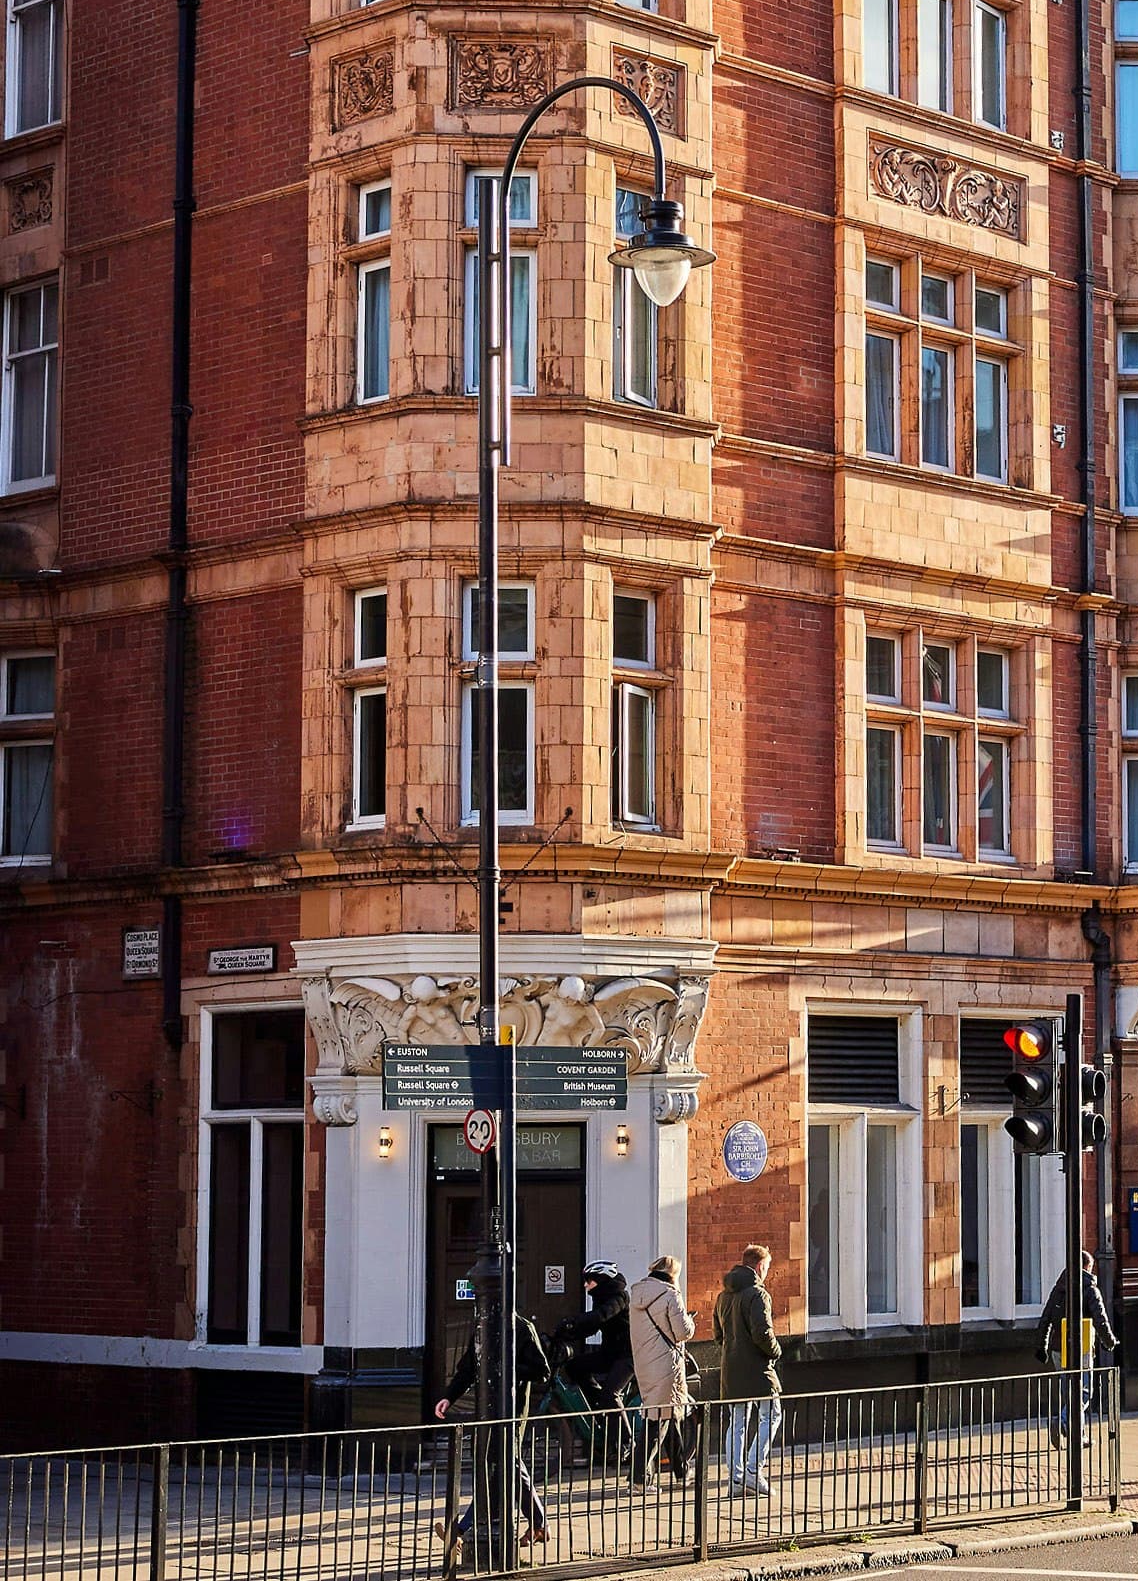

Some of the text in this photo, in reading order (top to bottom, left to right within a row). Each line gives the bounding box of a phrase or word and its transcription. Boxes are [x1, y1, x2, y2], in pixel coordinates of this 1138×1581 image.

[143, 931, 159, 942] PLACE
[219, 955, 239, 964] GEORGE
[247, 953, 270, 962] MARTYR
[227, 960, 266, 969] QUEEN SQUARE
[397, 1047, 428, 1056] EUSTON
[582, 1050, 616, 1058] HOLBORN
[396, 1063, 450, 1075] Russell Square
[556, 1066, 617, 1074] COVENT GARDEN
[397, 1080, 450, 1091] Russell Square
[563, 1082, 616, 1091] British Museum
[398, 1097, 474, 1107] University of London
[580, 1098, 609, 1107] Holborn
[469, 1120, 490, 1140] 20
[456, 1132, 561, 1145] BSBURY
[532, 1149, 561, 1163] BAR
